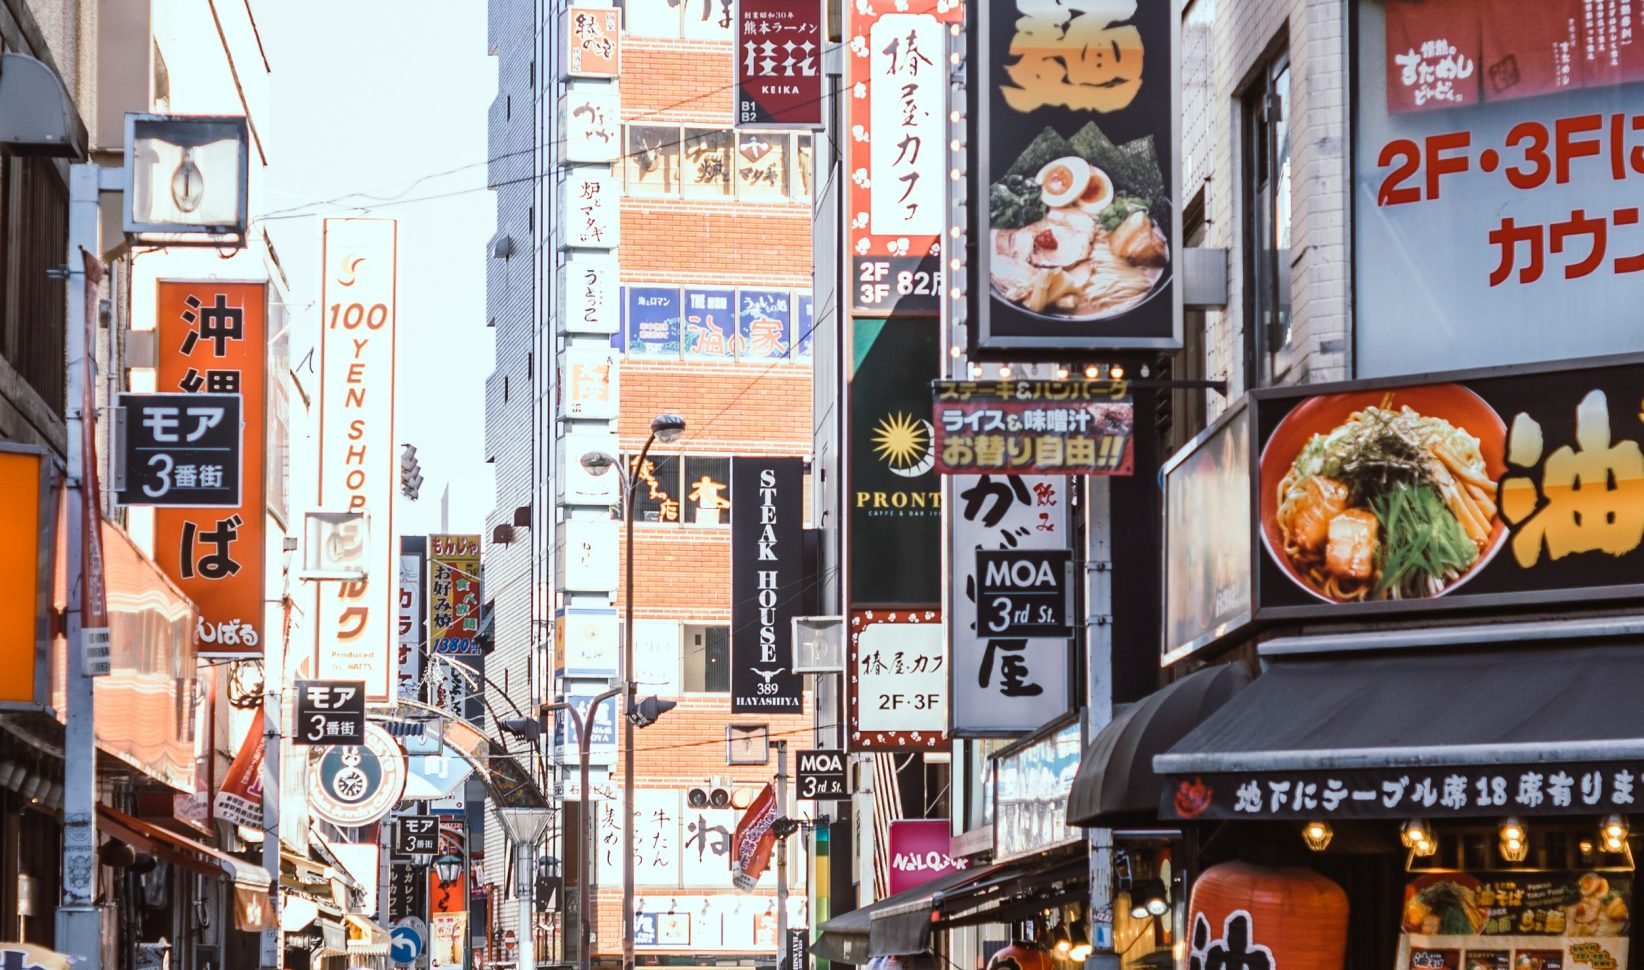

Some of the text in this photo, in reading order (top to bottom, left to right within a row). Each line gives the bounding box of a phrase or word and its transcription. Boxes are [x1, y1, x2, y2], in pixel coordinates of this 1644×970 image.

[743, 21, 819, 36] 熊本ラーメン
[761, 85, 800, 95] KEIKA
[741, 101, 756, 111] B1
[741, 112, 757, 122] B2
[859, 261, 890, 282] 2F
[859, 283, 890, 304] 3F
[329, 302, 389, 331] 100
[687, 313, 789, 357] 海の家
[344, 338, 370, 408] YEN
[142, 407, 225, 443] モア
[942, 408, 1092, 433] ライス&味噌汁
[142, 453, 225, 497] 3番街
[345, 418, 370, 513] SHOP
[757, 468, 779, 561] STEAK
[432, 538, 479, 557] もんじゃ
[960, 473, 1044, 698] か屋
[984, 560, 1057, 588] MOA
[433, 564, 454, 629] お好み焼
[757, 570, 779, 663] HOUSE
[988, 596, 1056, 633] 3rd St.
[307, 686, 356, 709] モア
[736, 696, 800, 707] HAYASHIYA
[756, 682, 780, 696] 389
[307, 714, 356, 742] 3番街
[800, 754, 843, 772] MOA
[802, 776, 843, 798] 3rd St.
[405, 819, 434, 833] モア
[601, 807, 623, 867] 麦めし
[651, 808, 672, 867] 牛たん
[405, 835, 434, 852] 3番街
